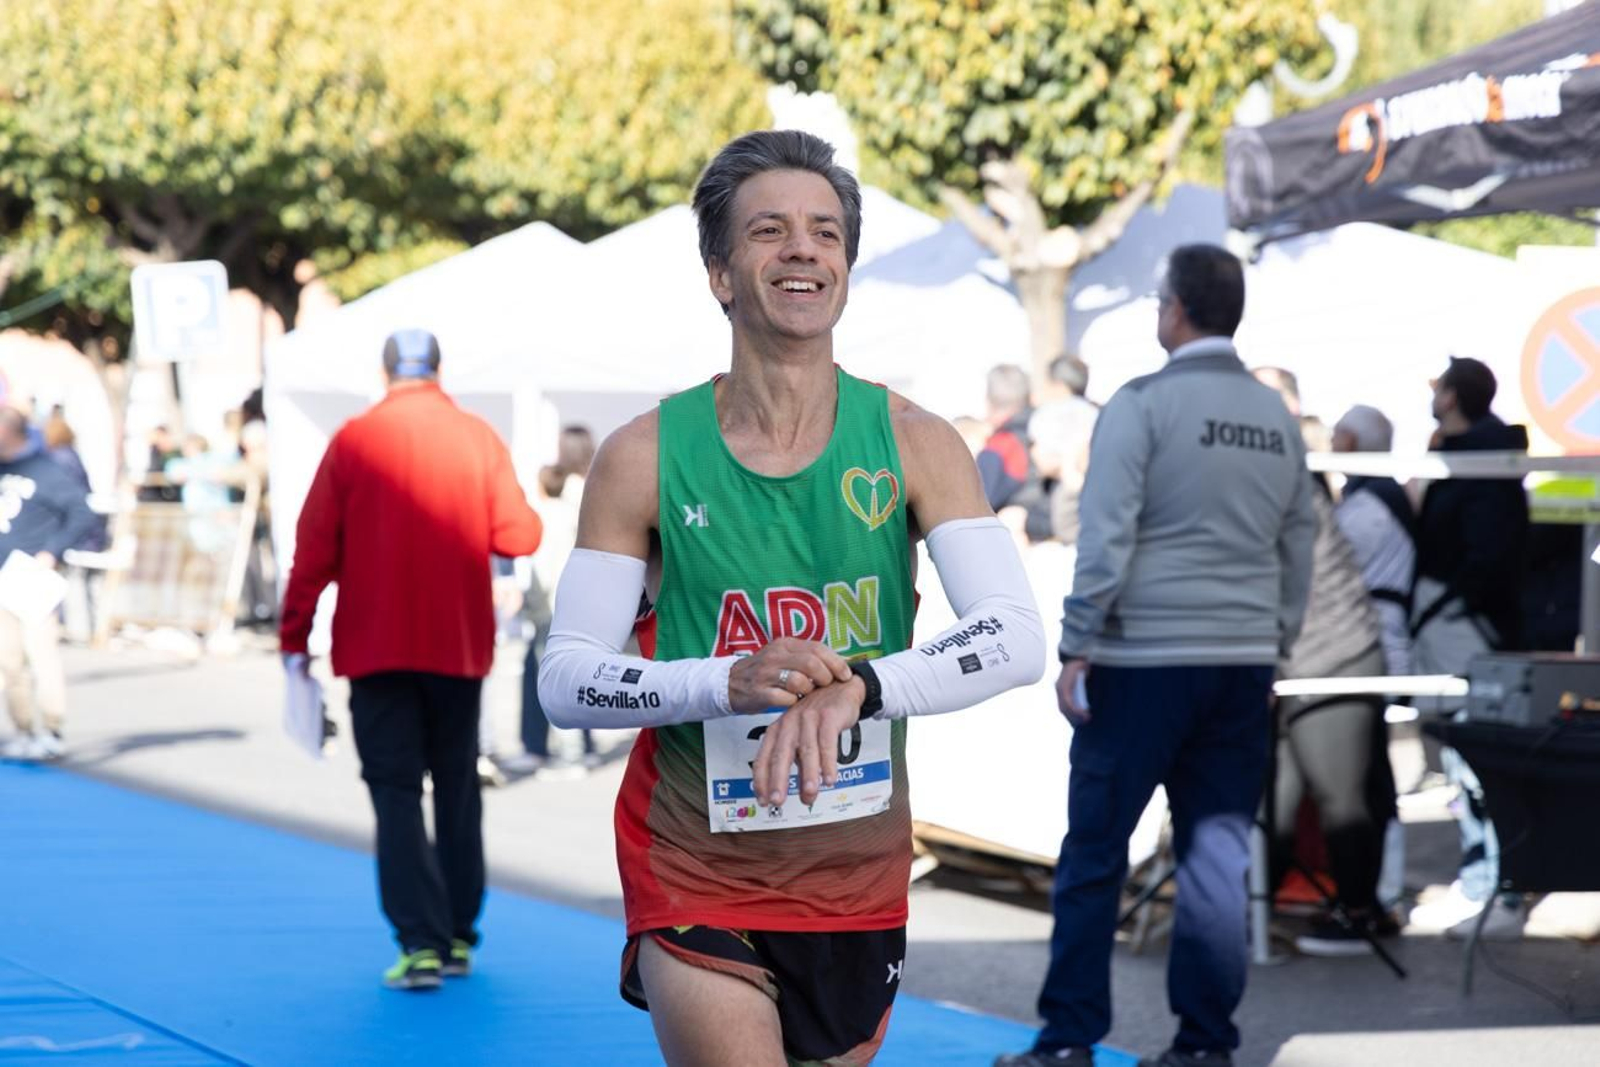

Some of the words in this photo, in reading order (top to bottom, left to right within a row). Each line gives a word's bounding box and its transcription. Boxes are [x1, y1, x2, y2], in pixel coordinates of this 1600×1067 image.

[1199, 419, 1285, 456] Joma
[710, 575, 882, 657] ADN
[577, 686, 660, 709] #Sevilla10
